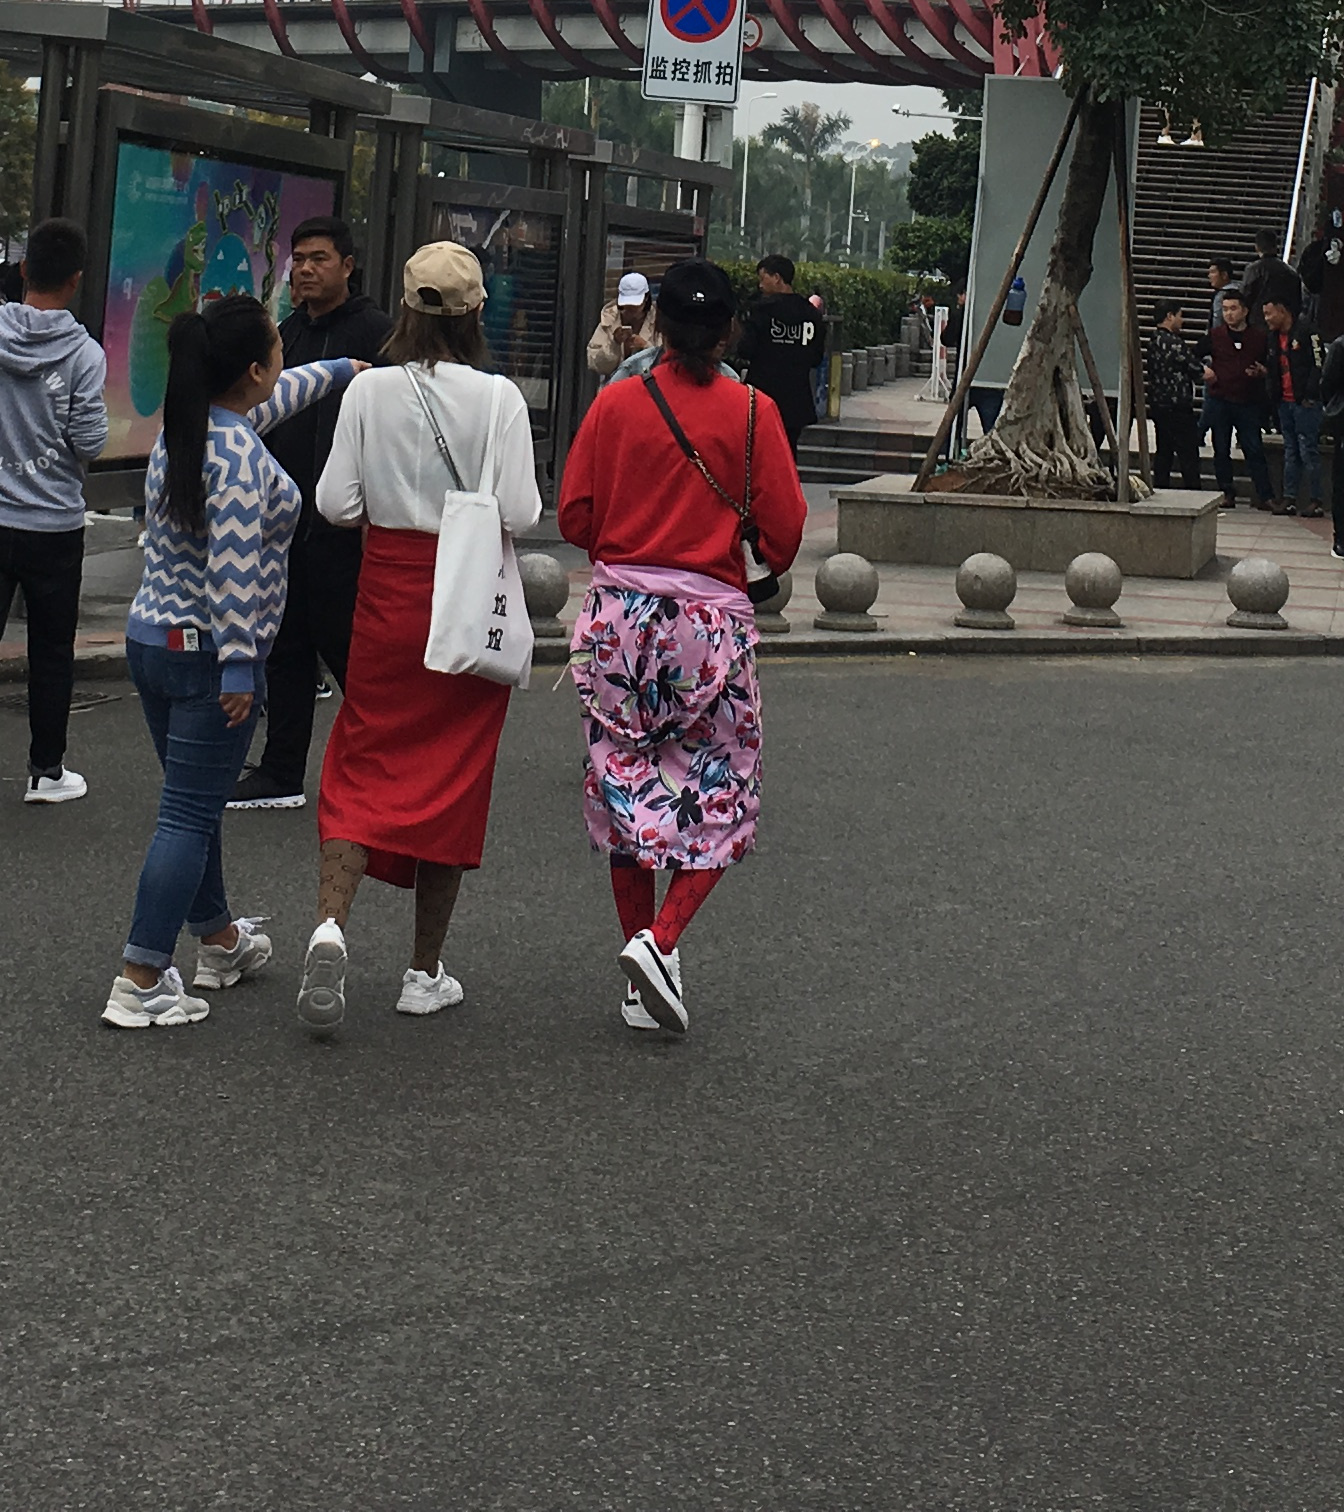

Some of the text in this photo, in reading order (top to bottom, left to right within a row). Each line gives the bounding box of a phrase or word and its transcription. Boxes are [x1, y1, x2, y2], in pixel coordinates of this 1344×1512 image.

[649, 55, 735, 87] 监控抓拍
[13, 448, 60, 476] CODE
